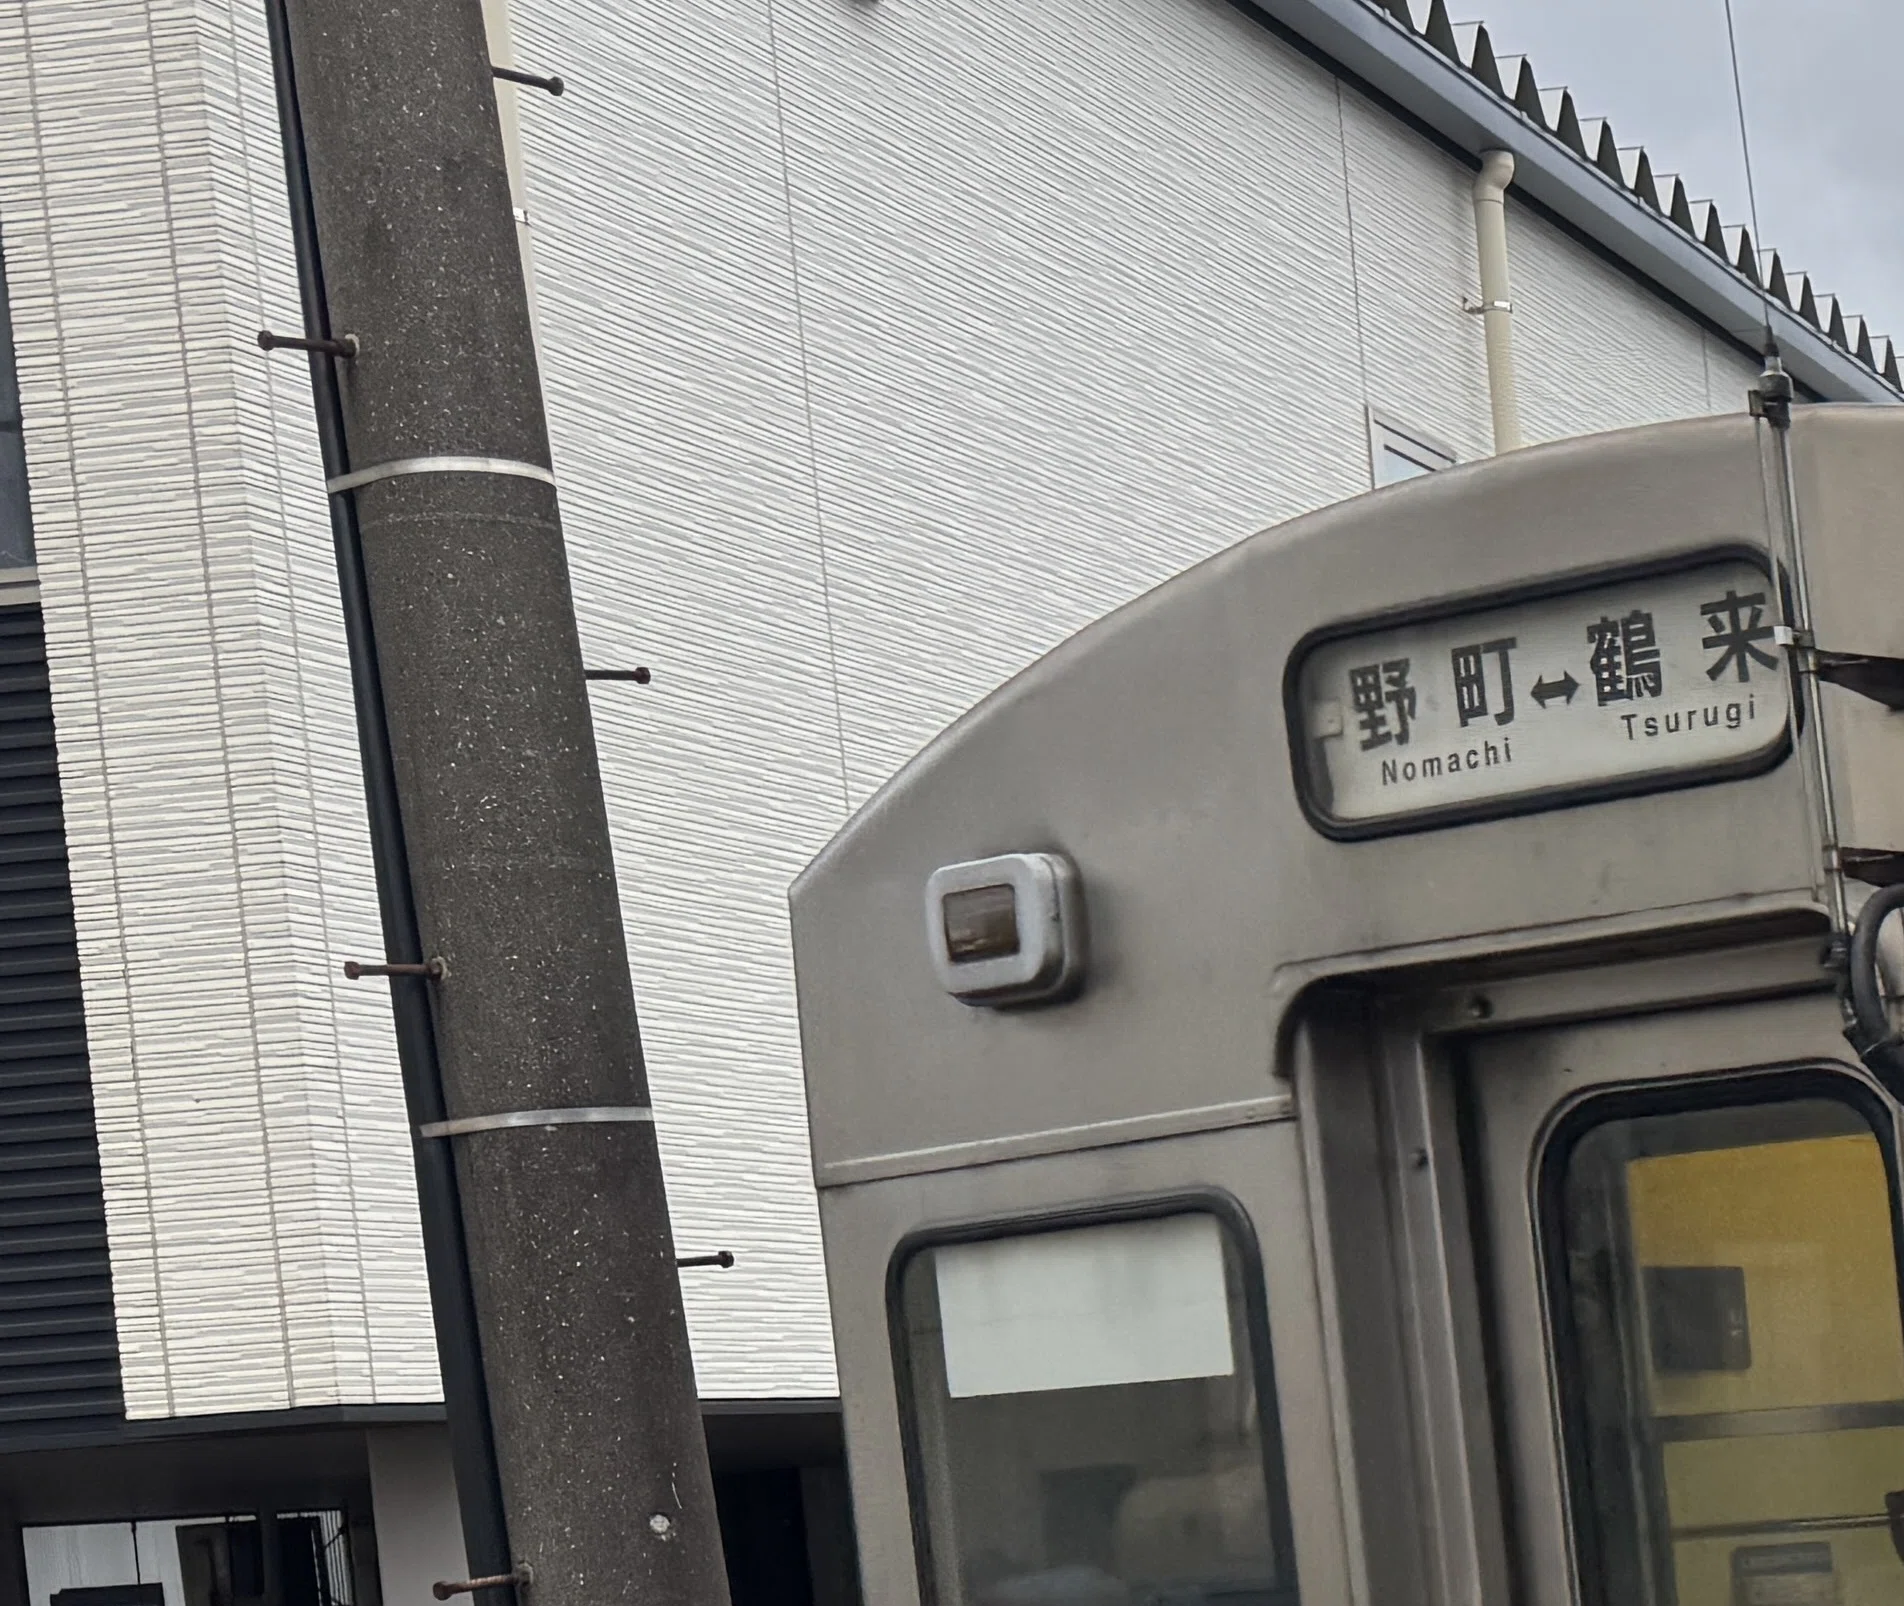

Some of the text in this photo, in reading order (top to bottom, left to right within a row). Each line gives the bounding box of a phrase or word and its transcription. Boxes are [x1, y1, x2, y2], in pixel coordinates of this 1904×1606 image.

[1349, 590, 1779, 751] 野町 鶴来
[1381, 693, 1756, 786] Nomachi Tsurugi
